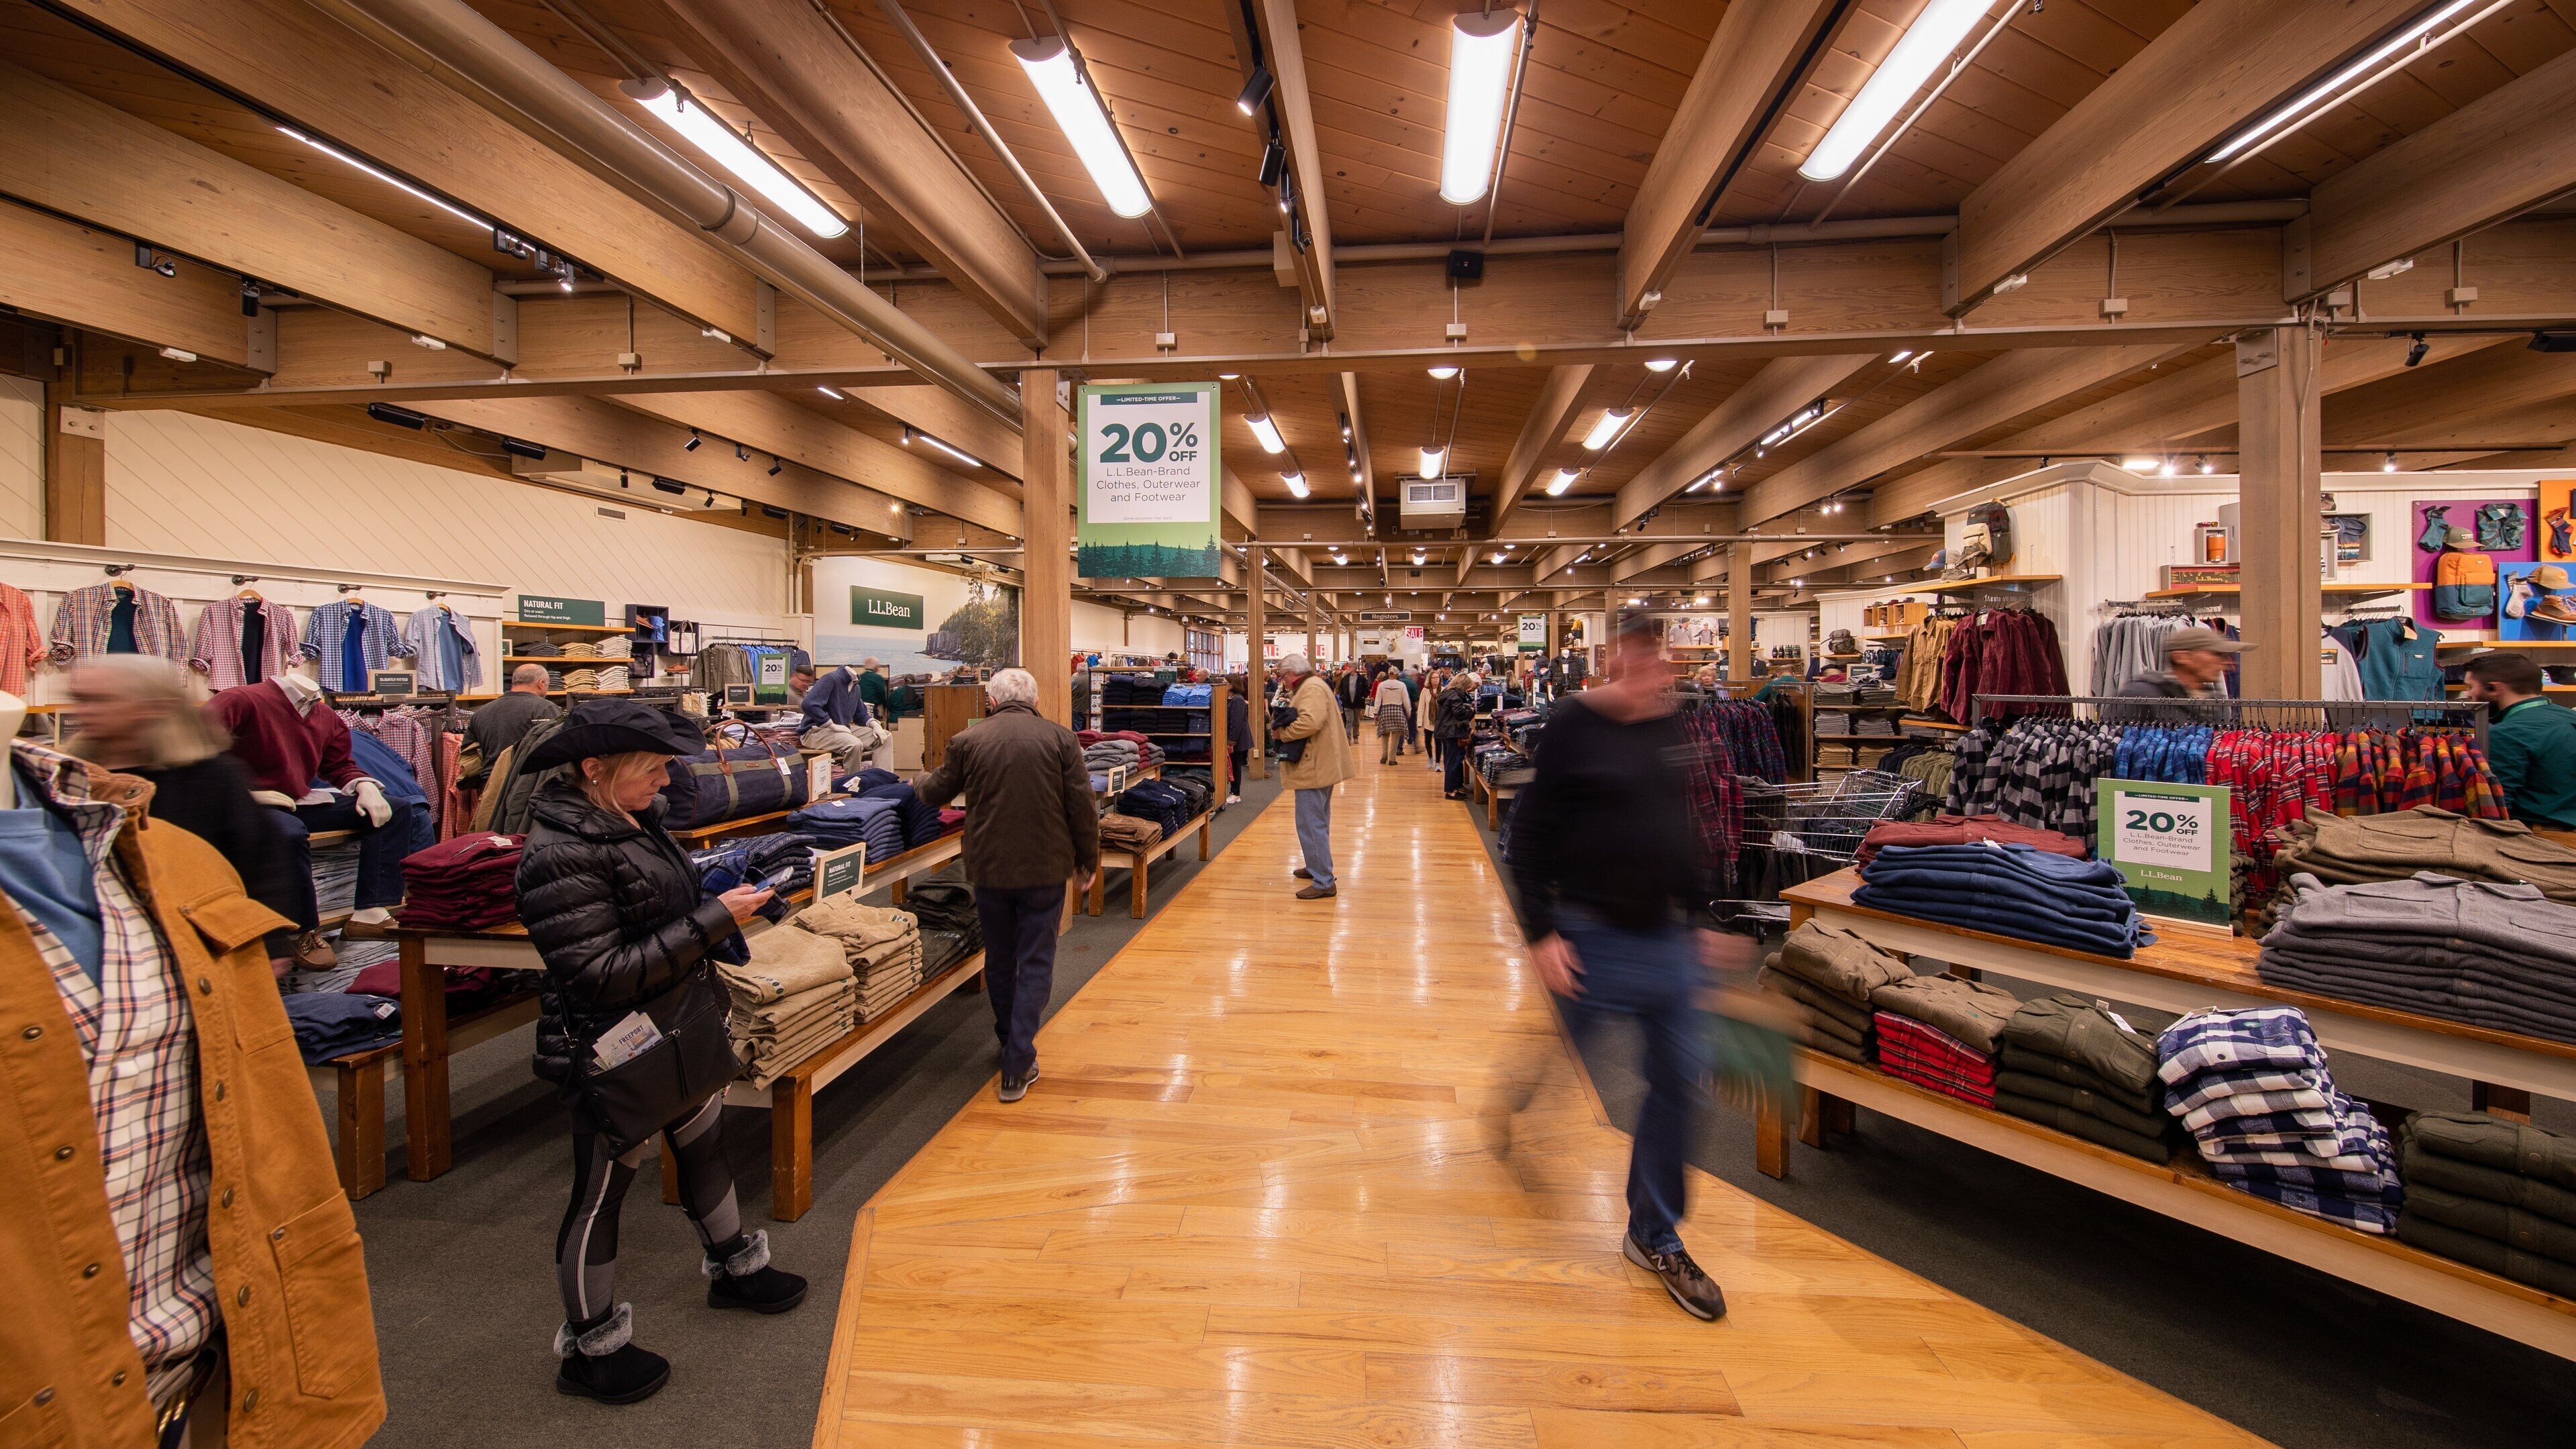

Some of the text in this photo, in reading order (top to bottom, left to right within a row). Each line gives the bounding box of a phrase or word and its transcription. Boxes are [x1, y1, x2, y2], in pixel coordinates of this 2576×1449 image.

[1169, 451, 1197, 462] OFF
[1106, 466, 1191, 477] L.L.Bean-Brand
[1096, 479, 1201, 490] Clothes, Outerwear
[1110, 492, 1186, 502] and Footwear
[524, 600, 564, 610] NATURAL FIT
[868, 599, 910, 617] L.L.Bean
[1406, 629, 1423, 639] SALE
[1263, 645, 1279, 657] ALE
[1303, 645, 1326, 658] SLE
[2130, 832, 2193, 843] L.L.Bean-Brand
[2123, 837, 2200, 851] Clothes, Outerwear
[2151, 847, 2189, 856] Footwear
[828, 863, 845, 874] NATURAL
[2141, 869, 2183, 881] L.L.Bean
[619, 1024, 644, 1045] FREEPORT
